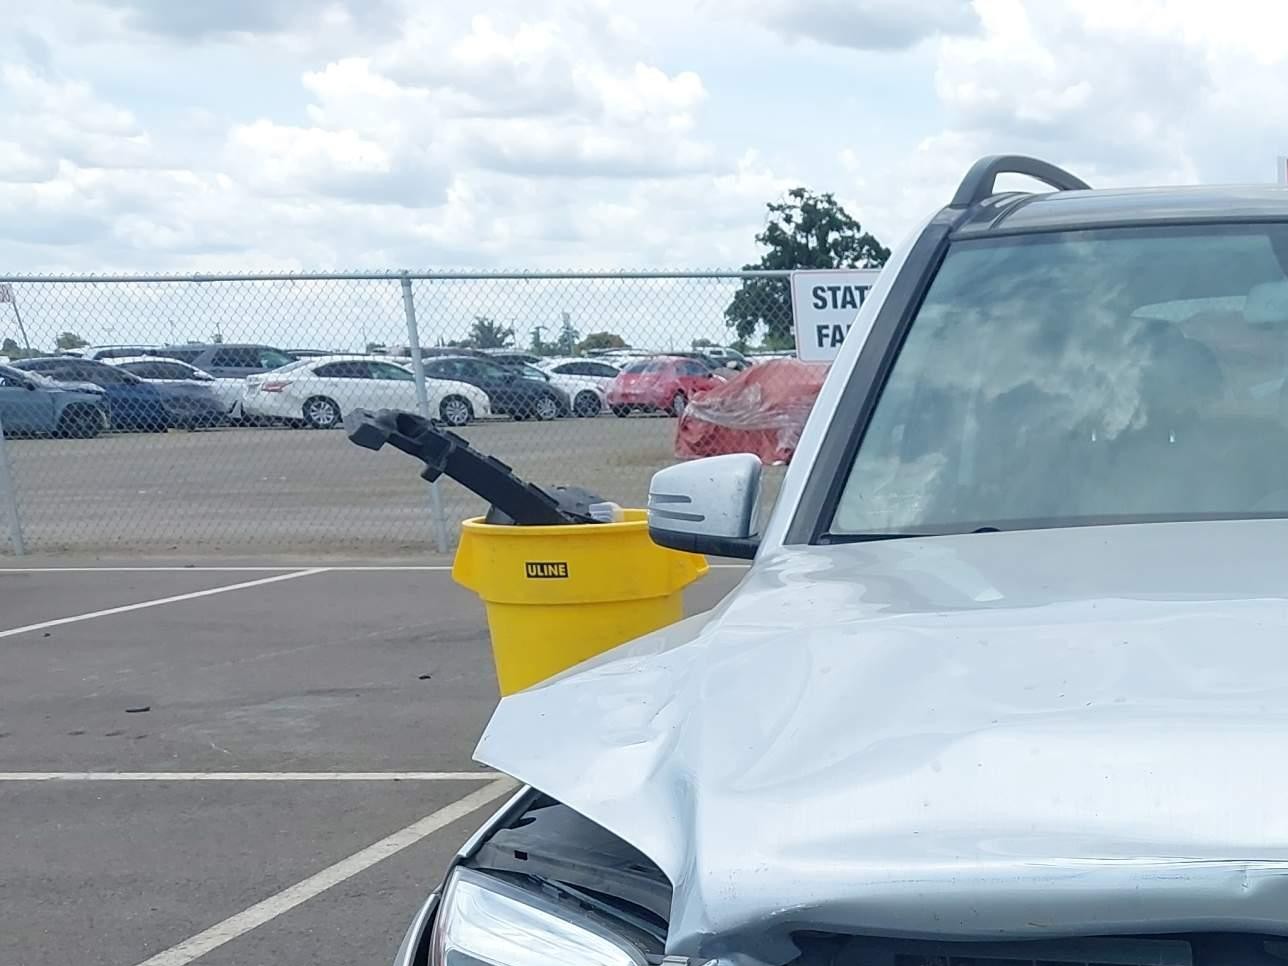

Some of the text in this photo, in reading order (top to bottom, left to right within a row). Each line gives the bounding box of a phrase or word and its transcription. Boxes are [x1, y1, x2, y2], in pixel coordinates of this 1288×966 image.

[812, 285, 873, 310] STAT
[816, 324, 852, 348] FA
[527, 564, 567, 577] ULINE
